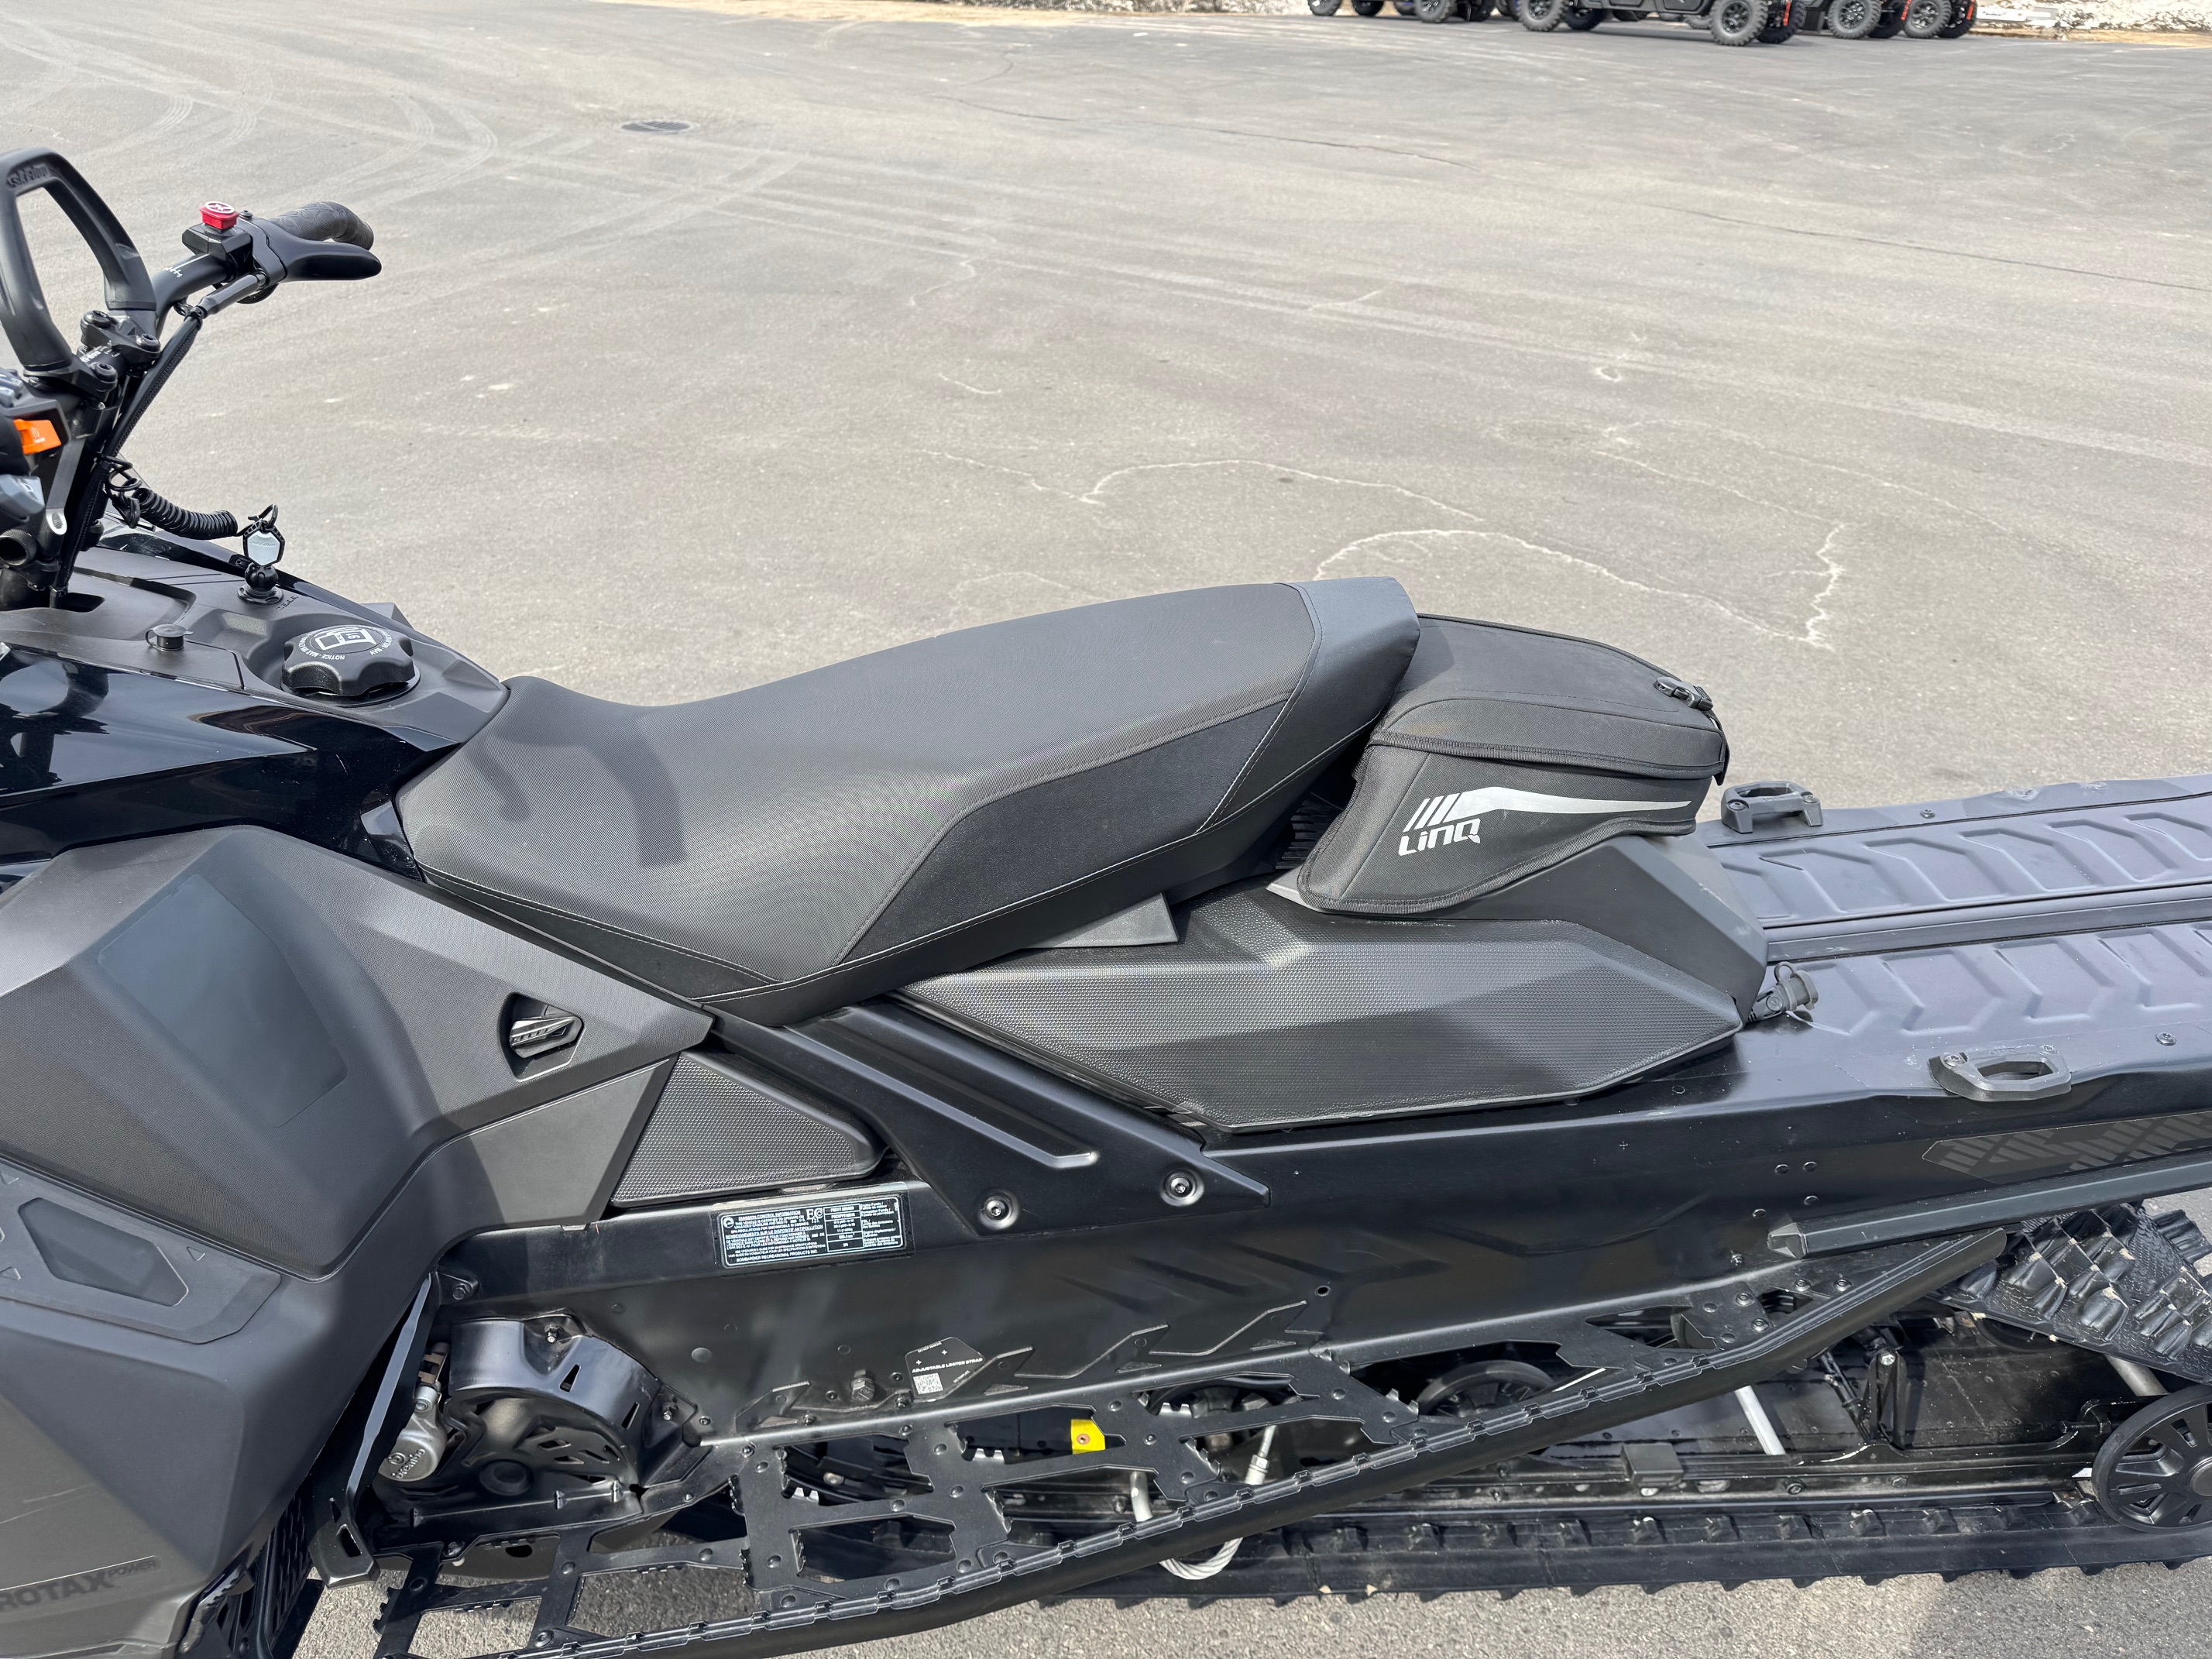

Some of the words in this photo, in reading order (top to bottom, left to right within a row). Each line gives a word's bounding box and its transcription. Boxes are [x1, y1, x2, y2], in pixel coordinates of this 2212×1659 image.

[912, 1364, 946, 1373] ADJUSTABLE
[391, 1449, 425, 1479] brembo
[0, 1571, 116, 1612] ROTAX
[108, 1559, 156, 1577] POWER
